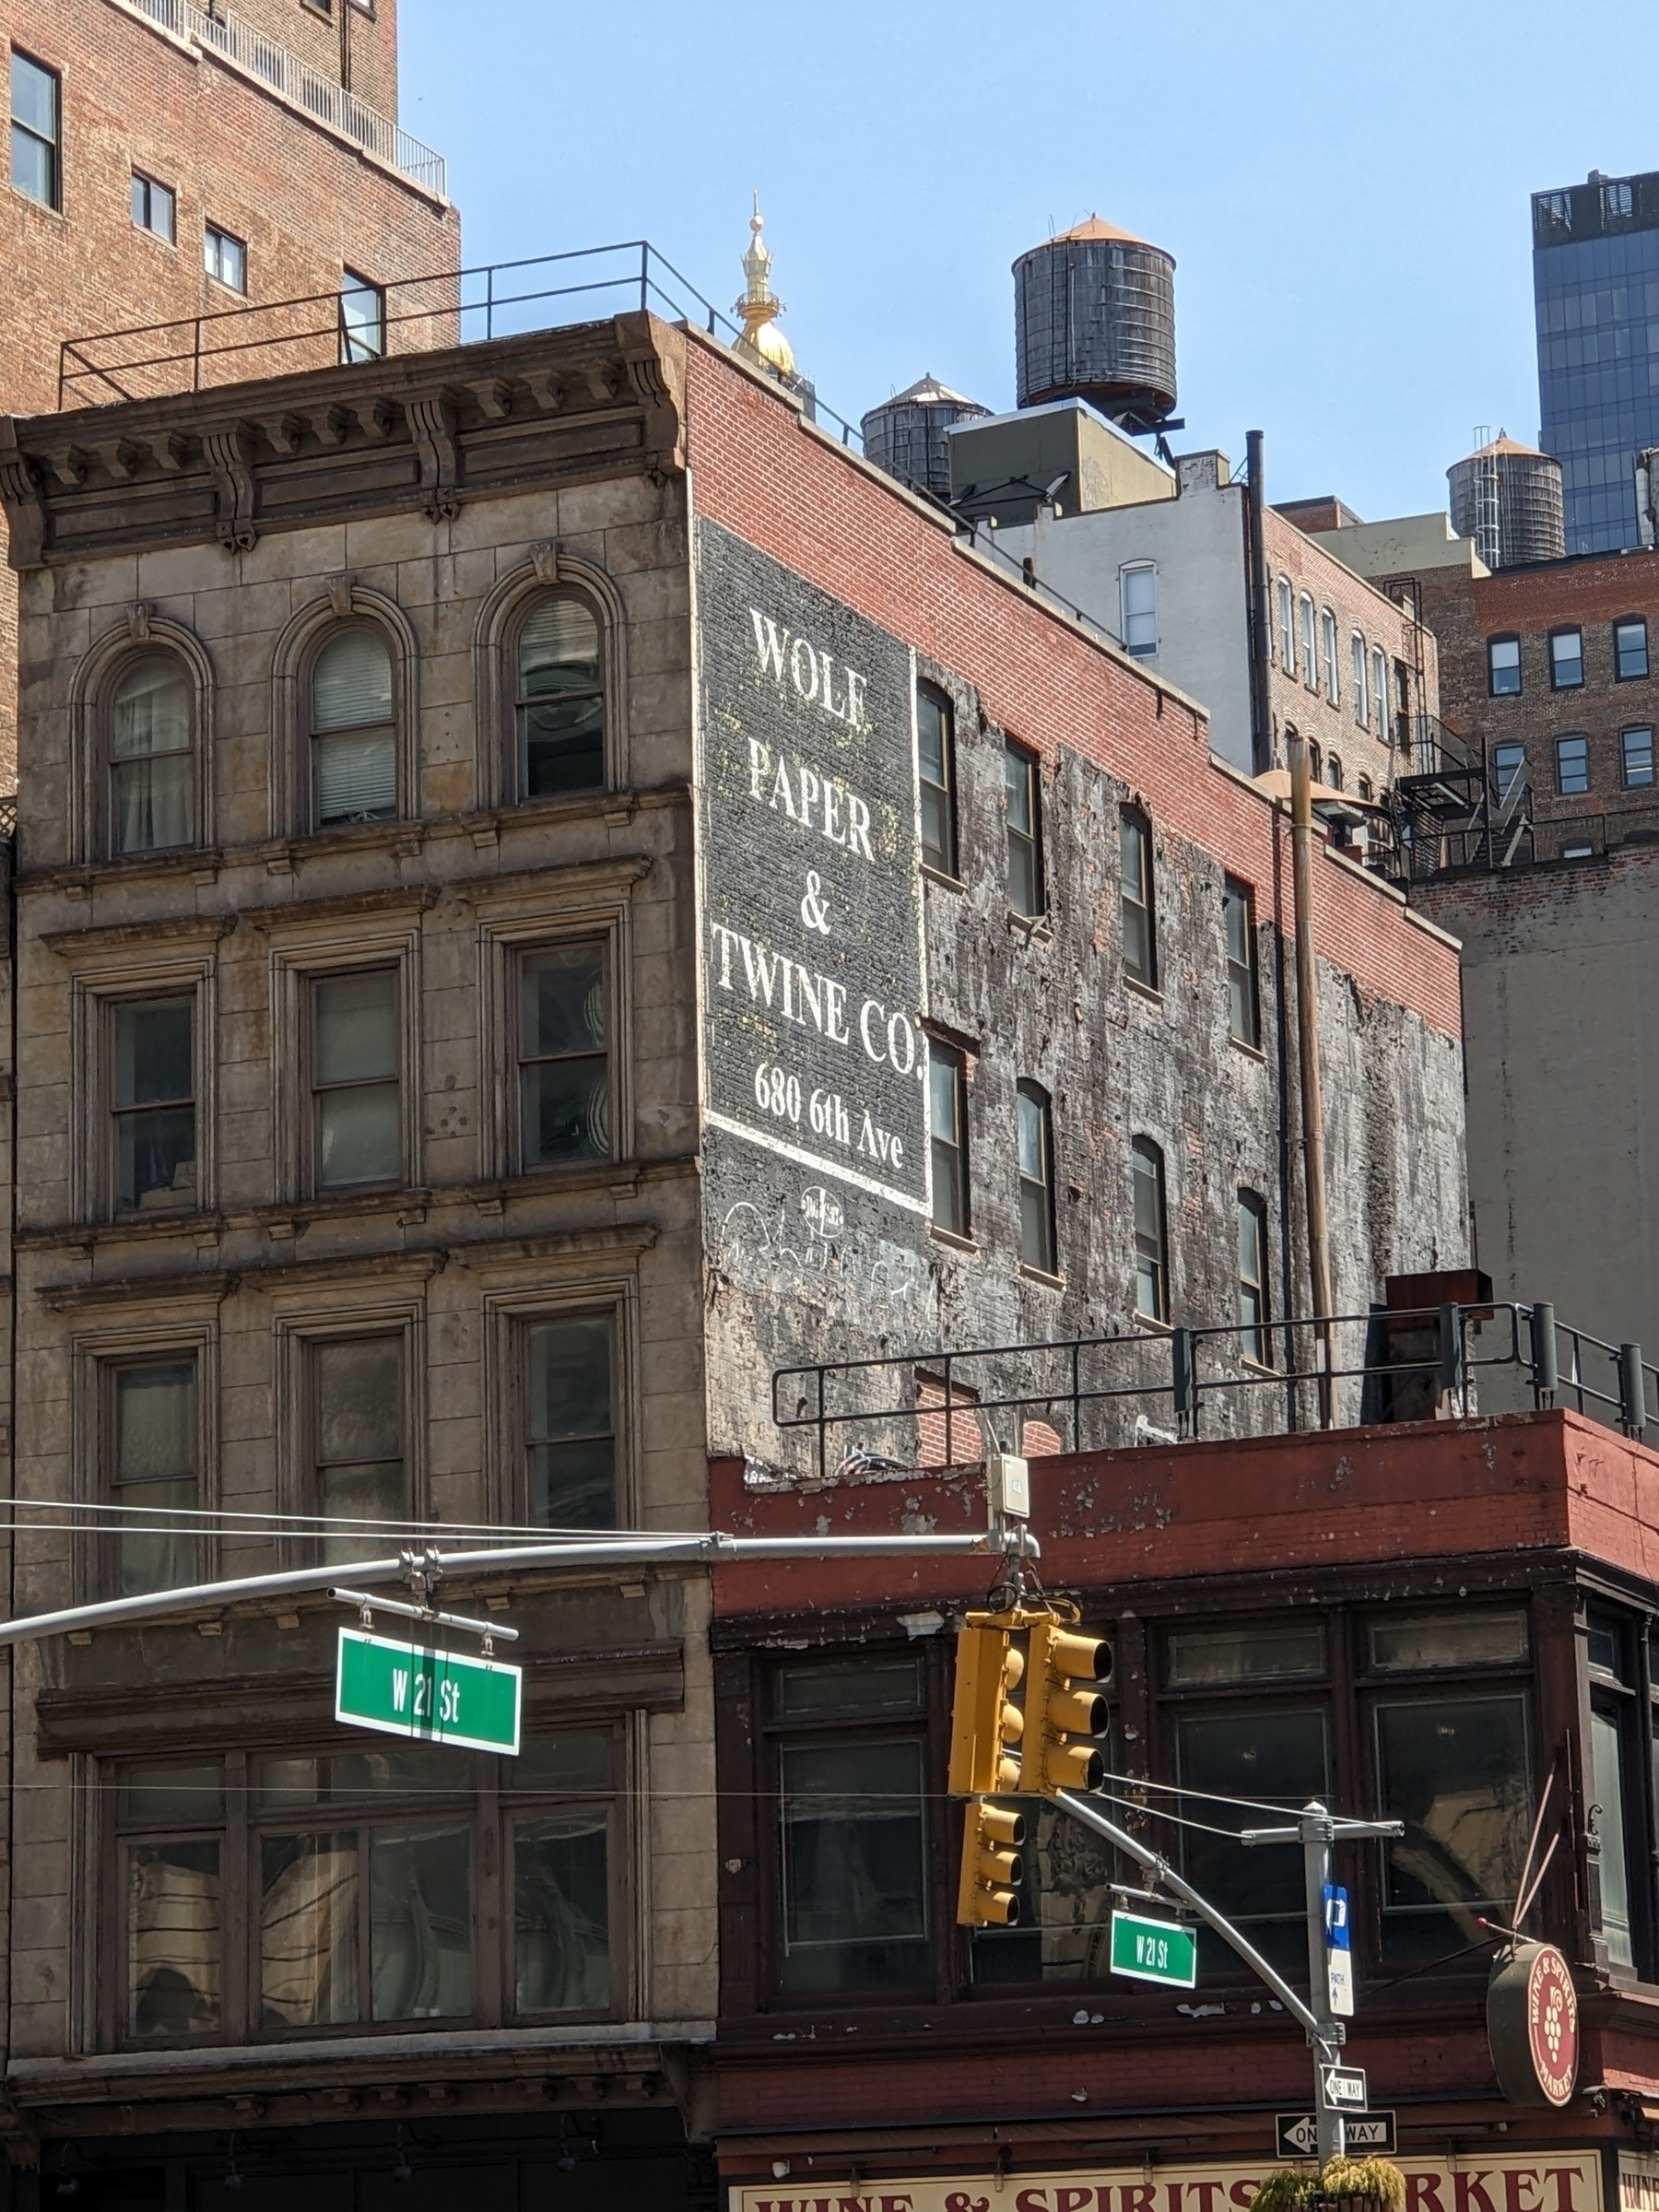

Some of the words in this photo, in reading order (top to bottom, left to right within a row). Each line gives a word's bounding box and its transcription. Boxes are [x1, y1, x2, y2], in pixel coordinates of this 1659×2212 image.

[749, 606, 867, 726] WOLF
[747, 736, 875, 862] PAPER
[801, 870, 830, 935] &
[712, 922, 850, 1045] TWINE
[861, 1000, 923, 1079] CO.
[755, 1063, 801, 1123] 680
[809, 1088, 850, 1147] 6th
[857, 1109, 903, 1169] Ave
[393, 1668, 407, 1712] W
[413, 1673, 432, 1717] 21
[439, 1679, 460, 1724] St
[1136, 1935, 1145, 1964] W
[1146, 1936, 1156, 1967] 21
[1158, 1939, 1168, 1970] St
[1331, 1971, 1345, 1985] PATH
[1532, 1965, 1544, 2024] WINE
[1543, 1957, 1550, 1974] &
[1551, 1957, 1575, 2033] SPIRITS
[1330, 2078, 1343, 2096] ONE
[1347, 2081, 1359, 2098] WAY
[1540, 2062, 1572, 2097] MARKET
[1296, 2124, 1317, 2143] ON
[1347, 2124, 1379, 2141] WAY
[1405, 2167, 1584, 2212] RKET
